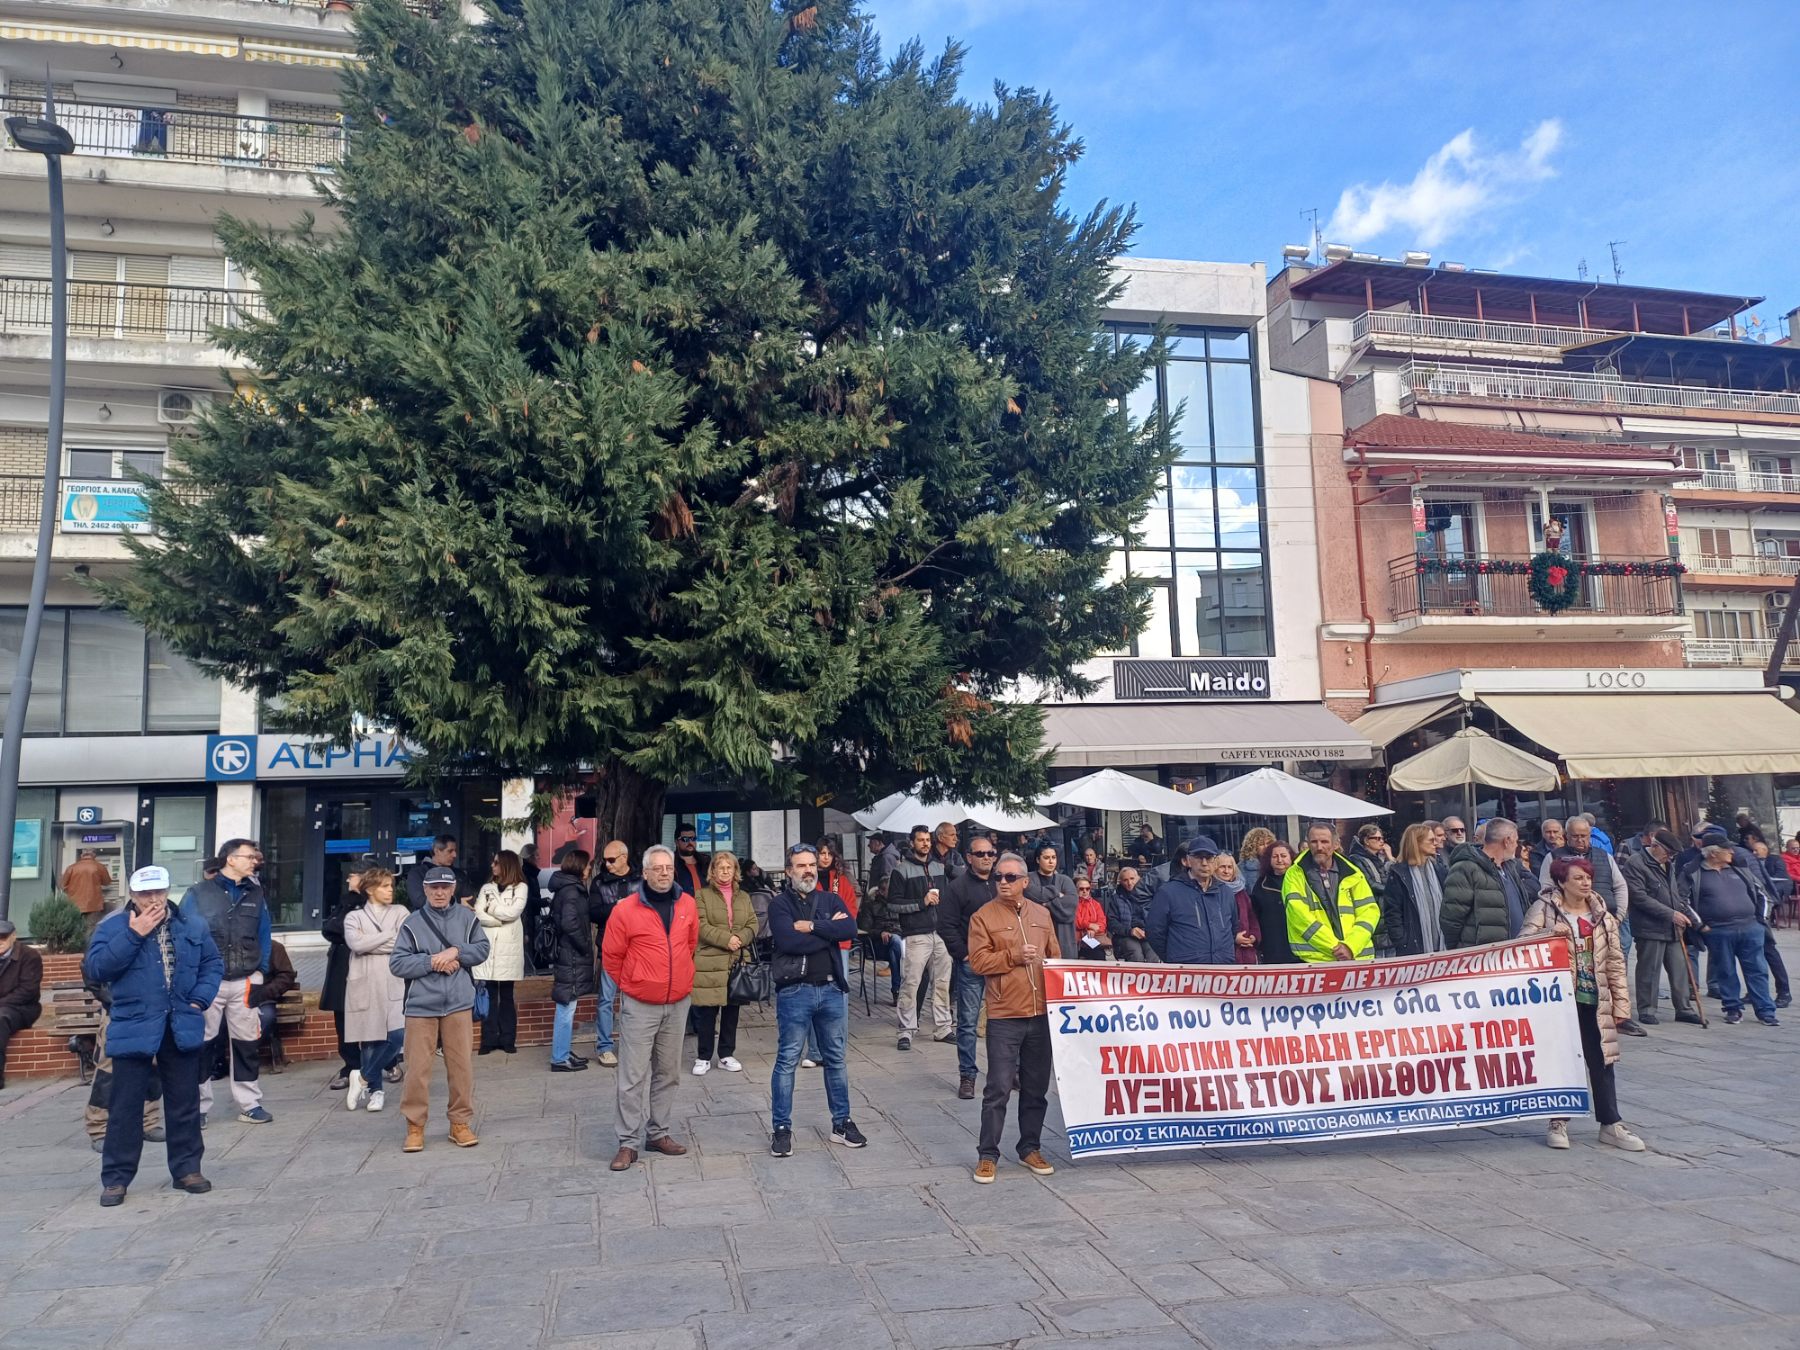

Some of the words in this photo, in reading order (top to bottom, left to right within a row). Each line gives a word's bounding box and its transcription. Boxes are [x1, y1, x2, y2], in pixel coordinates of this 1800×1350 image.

[1190, 671, 1266, 692] Maido
[1586, 672, 1646, 688] LOCO
[268, 741, 412, 769] ALPHA
[1259, 749, 1321, 759] VERGNANO
[1323, 749, 1345, 758] 1882
[1063, 971, 1100, 997] ΔΕΝ
[1107, 972, 1325, 996] ΠΡΟΣΑΡΜΟΖΟΜΑΣΤΕ
[1341, 972, 1367, 990] ΔΕ
[1370, 943, 1553, 988] ΣΥΜΒΙΒΑΖΟΜΑΣΤΕ
[1059, 1004, 1159, 1034] Σχολείο
[1168, 1008, 1211, 1030] που
[1220, 1002, 1251, 1026] θα
[1262, 996, 1383, 1032] μορφώνει
[1394, 987, 1441, 1015] όλα
[1448, 992, 1481, 1010] τα
[1489, 976, 1563, 1007] παιδιά
[1100, 1039, 1234, 1075] ΣΥΛΛΟΓΙΚΗ
[1236, 1031, 1353, 1070] ΣΥΜΒΑΣΗ
[1355, 1023, 1467, 1060] ΕΡΓΑΣΙΑΣ
[1470, 1018, 1535, 1049] ΤΩΡΑ
[1104, 1073, 1245, 1116] ΑΥΞΗΣΕΙΣ
[1244, 1066, 1336, 1109] ΣΤΟΥΣ
[1338, 1056, 1472, 1102] ΜΙΣΘΟΥΣ
[1474, 1050, 1538, 1090] ΜΑΣ
[1069, 1127, 1144, 1148] ΣΥΛΛΟΓΟΣ
[1149, 1122, 1275, 1140] ΕΚΠΑΙΔΕΥΤΙΚΩΝ
[1277, 1111, 1396, 1133] ΠΡΩΤΟΒΑΘΜΙΑΣ
[1398, 1101, 1502, 1122] ΕΚΠΑΙΔΕΥΣΗΣ
[1504, 1094, 1583, 1113] ΓΡΕΒΕΝΩΝ
